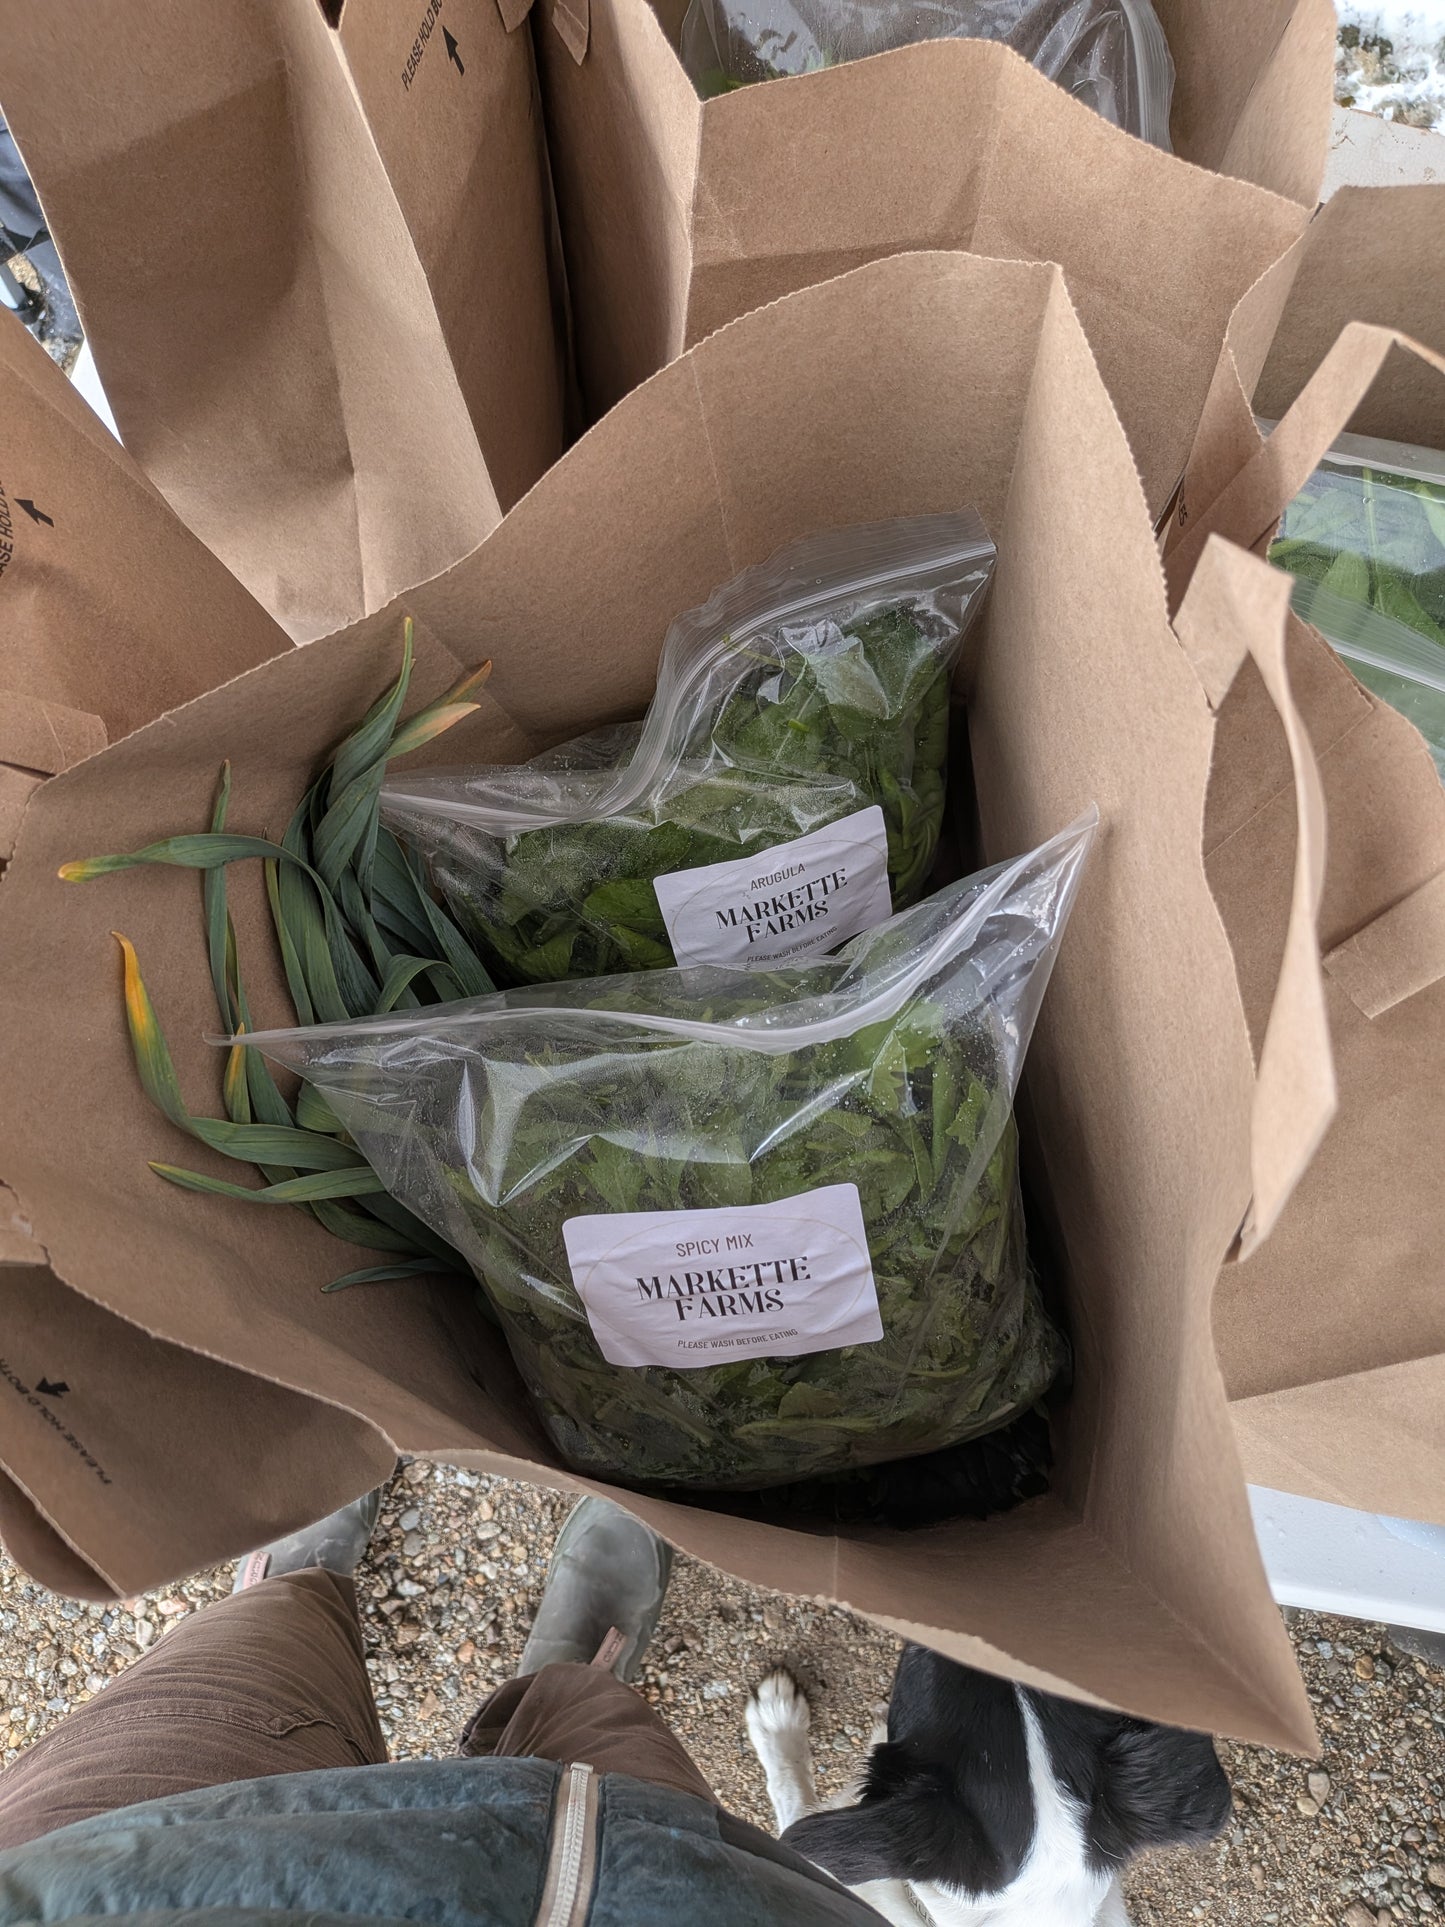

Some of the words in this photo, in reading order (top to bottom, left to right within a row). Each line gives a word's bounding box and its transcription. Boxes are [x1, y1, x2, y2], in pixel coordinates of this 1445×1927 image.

[401, 38, 424, 92] PLEASE
[418, 8, 435, 48] HOLD
[750, 863, 806, 891] ARUGULA
[715, 868, 849, 930] MARKETTE
[745, 900, 829, 944] FARMS
[773, 949, 791, 960] WASH
[816, 926, 838, 942] EATING
[675, 1237, 721, 1258] SPICY
[726, 1234, 754, 1251] MIX
[635, 1256, 812, 1301] MARKETTE
[674, 1288, 785, 1322] FARMS
[677, 1340, 709, 1349] PLEASE
[710, 1339, 735, 1349] WASH
[735, 1334, 769, 1346] BEFORE
[769, 1328, 799, 1341] EATING
